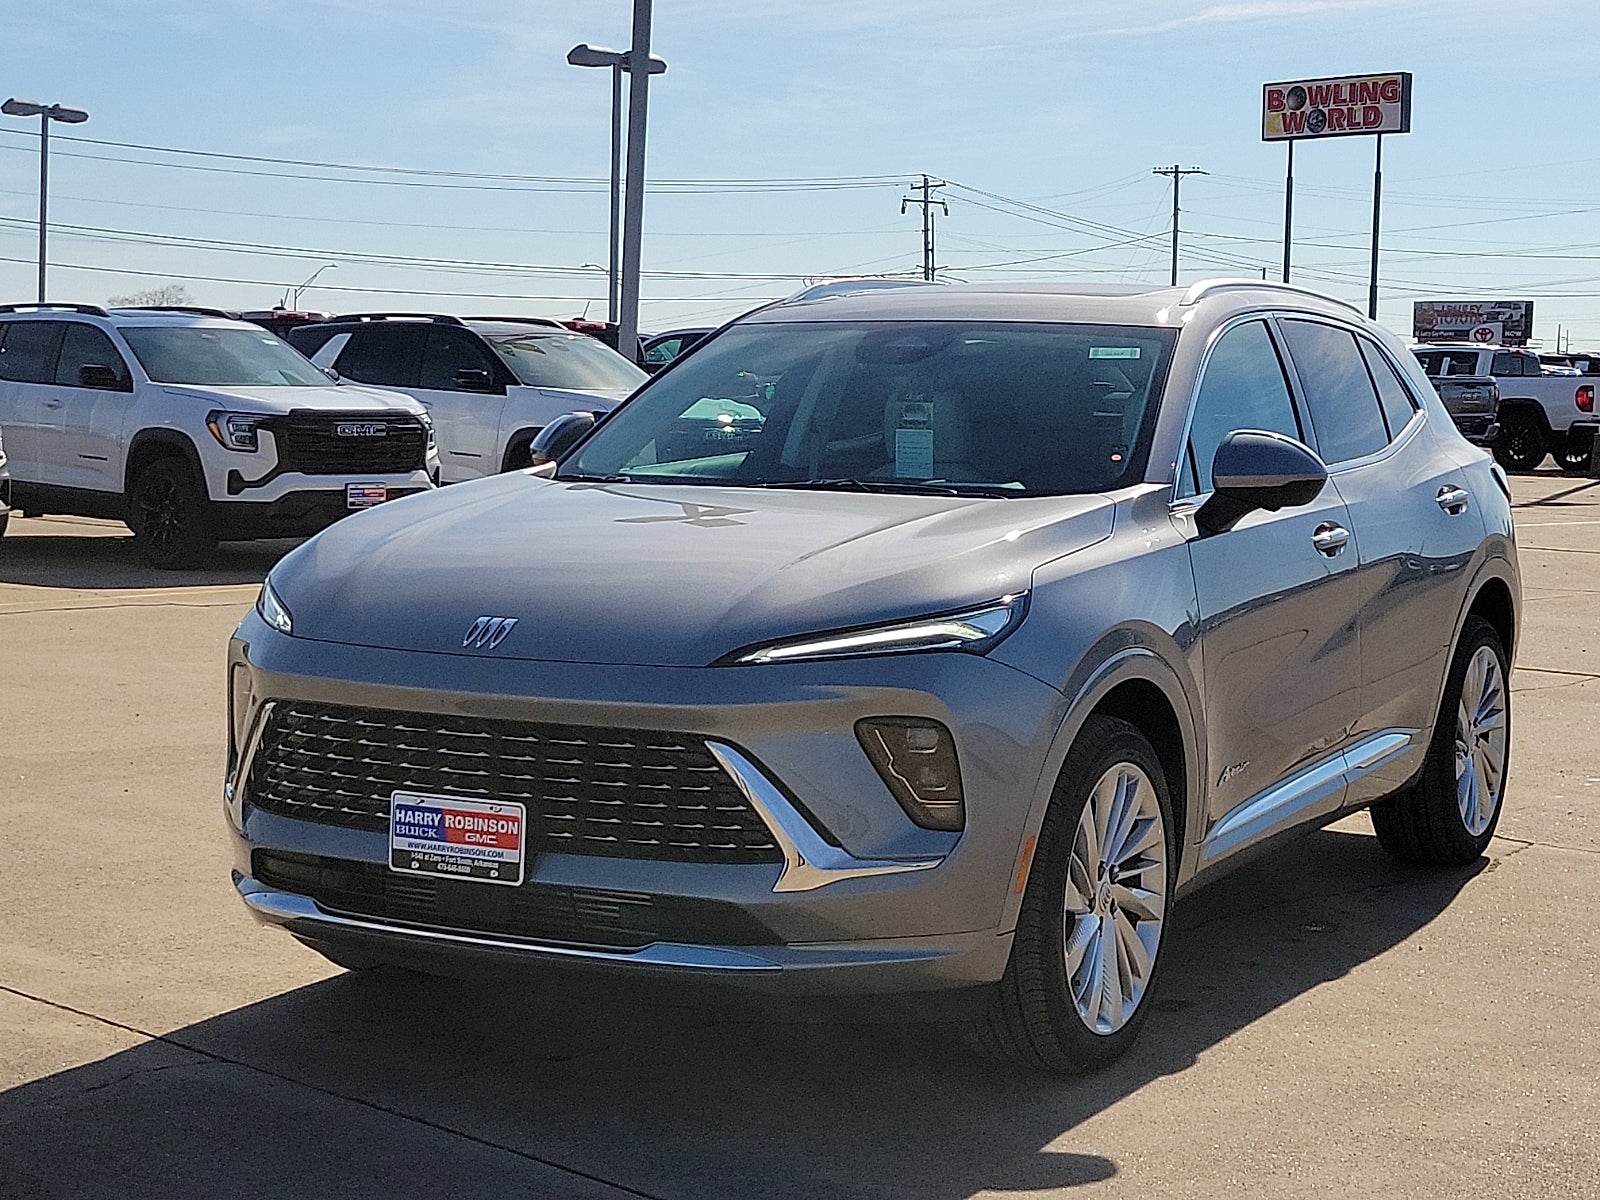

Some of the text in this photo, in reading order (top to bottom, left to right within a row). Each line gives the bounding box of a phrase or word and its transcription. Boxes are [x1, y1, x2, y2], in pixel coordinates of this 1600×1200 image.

[1267, 79, 1399, 111] BOWLING
[1281, 105, 1383, 134] WORLD
[337, 424, 387, 436] GMC
[395, 809, 519, 834] HARRY ROBINSON
[396, 824, 498, 844] BUICK GMC
[407, 842, 504, 859] WWW.HARRYROBINSON.COM
